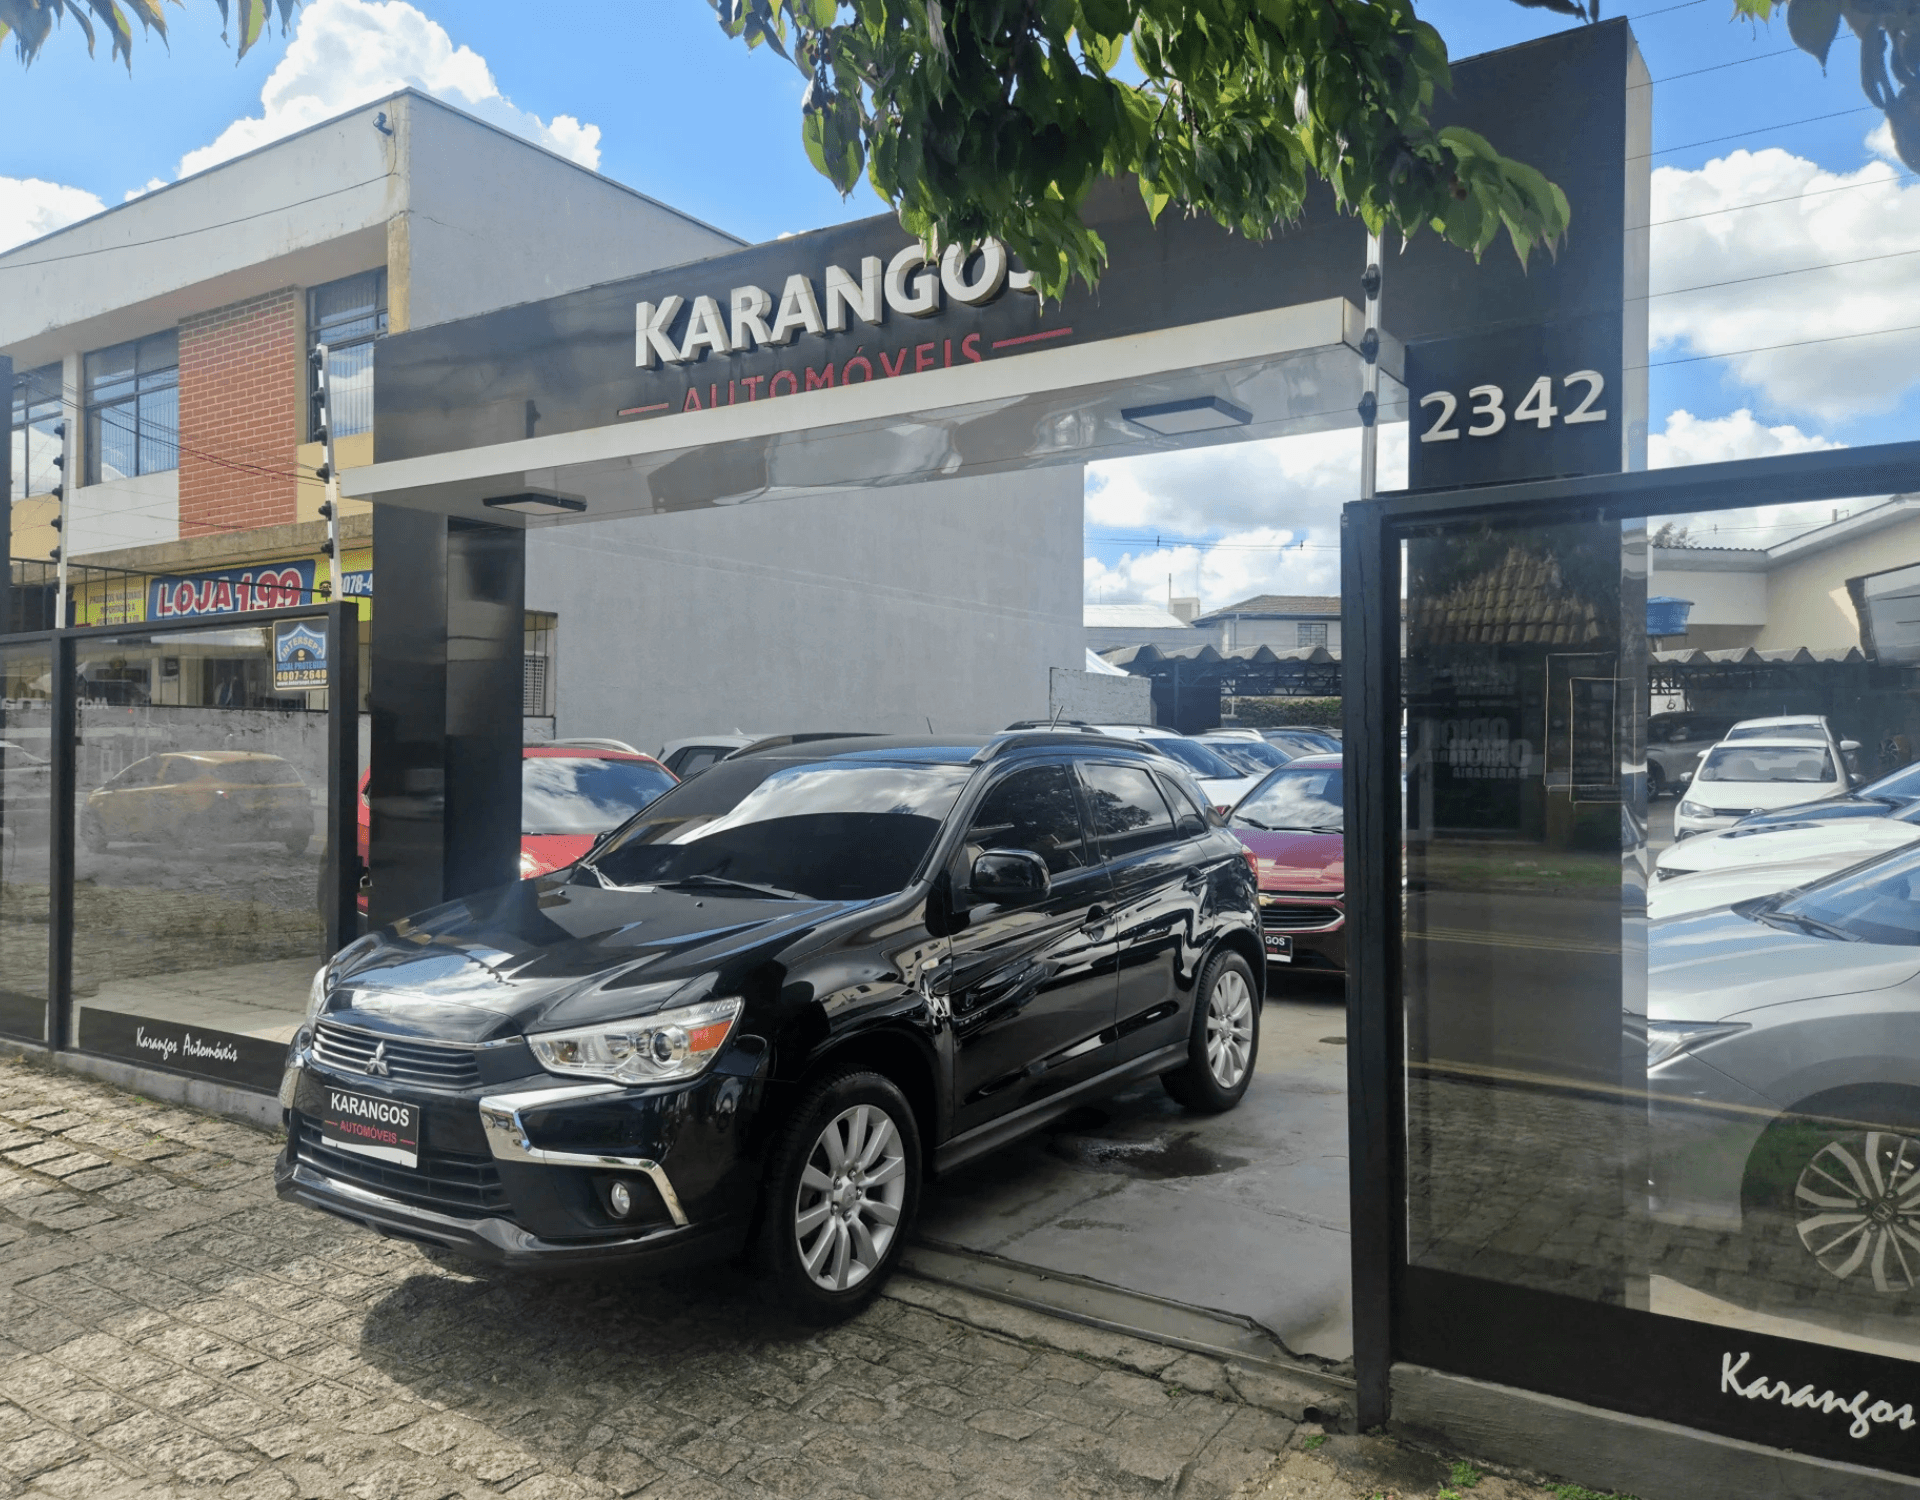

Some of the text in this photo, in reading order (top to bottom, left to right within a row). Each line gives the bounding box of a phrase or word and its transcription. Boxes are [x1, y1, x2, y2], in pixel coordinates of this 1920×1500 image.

[635, 236, 1038, 371] KARANGO
[1419, 369, 1607, 443] 2342
[156, 576, 233, 617] LOJA
[281, 636, 323, 657] INTERSEPT
[276, 662, 293, 671] LOCAL
[276, 669, 327, 681] 4007-2640
[136, 1026, 178, 1060] Karangos
[331, 1092, 410, 1127] KARANGOS
[339, 1119, 398, 1145] AUTOMÓVEIS
[1720, 1351, 1917, 1439] Karangos
